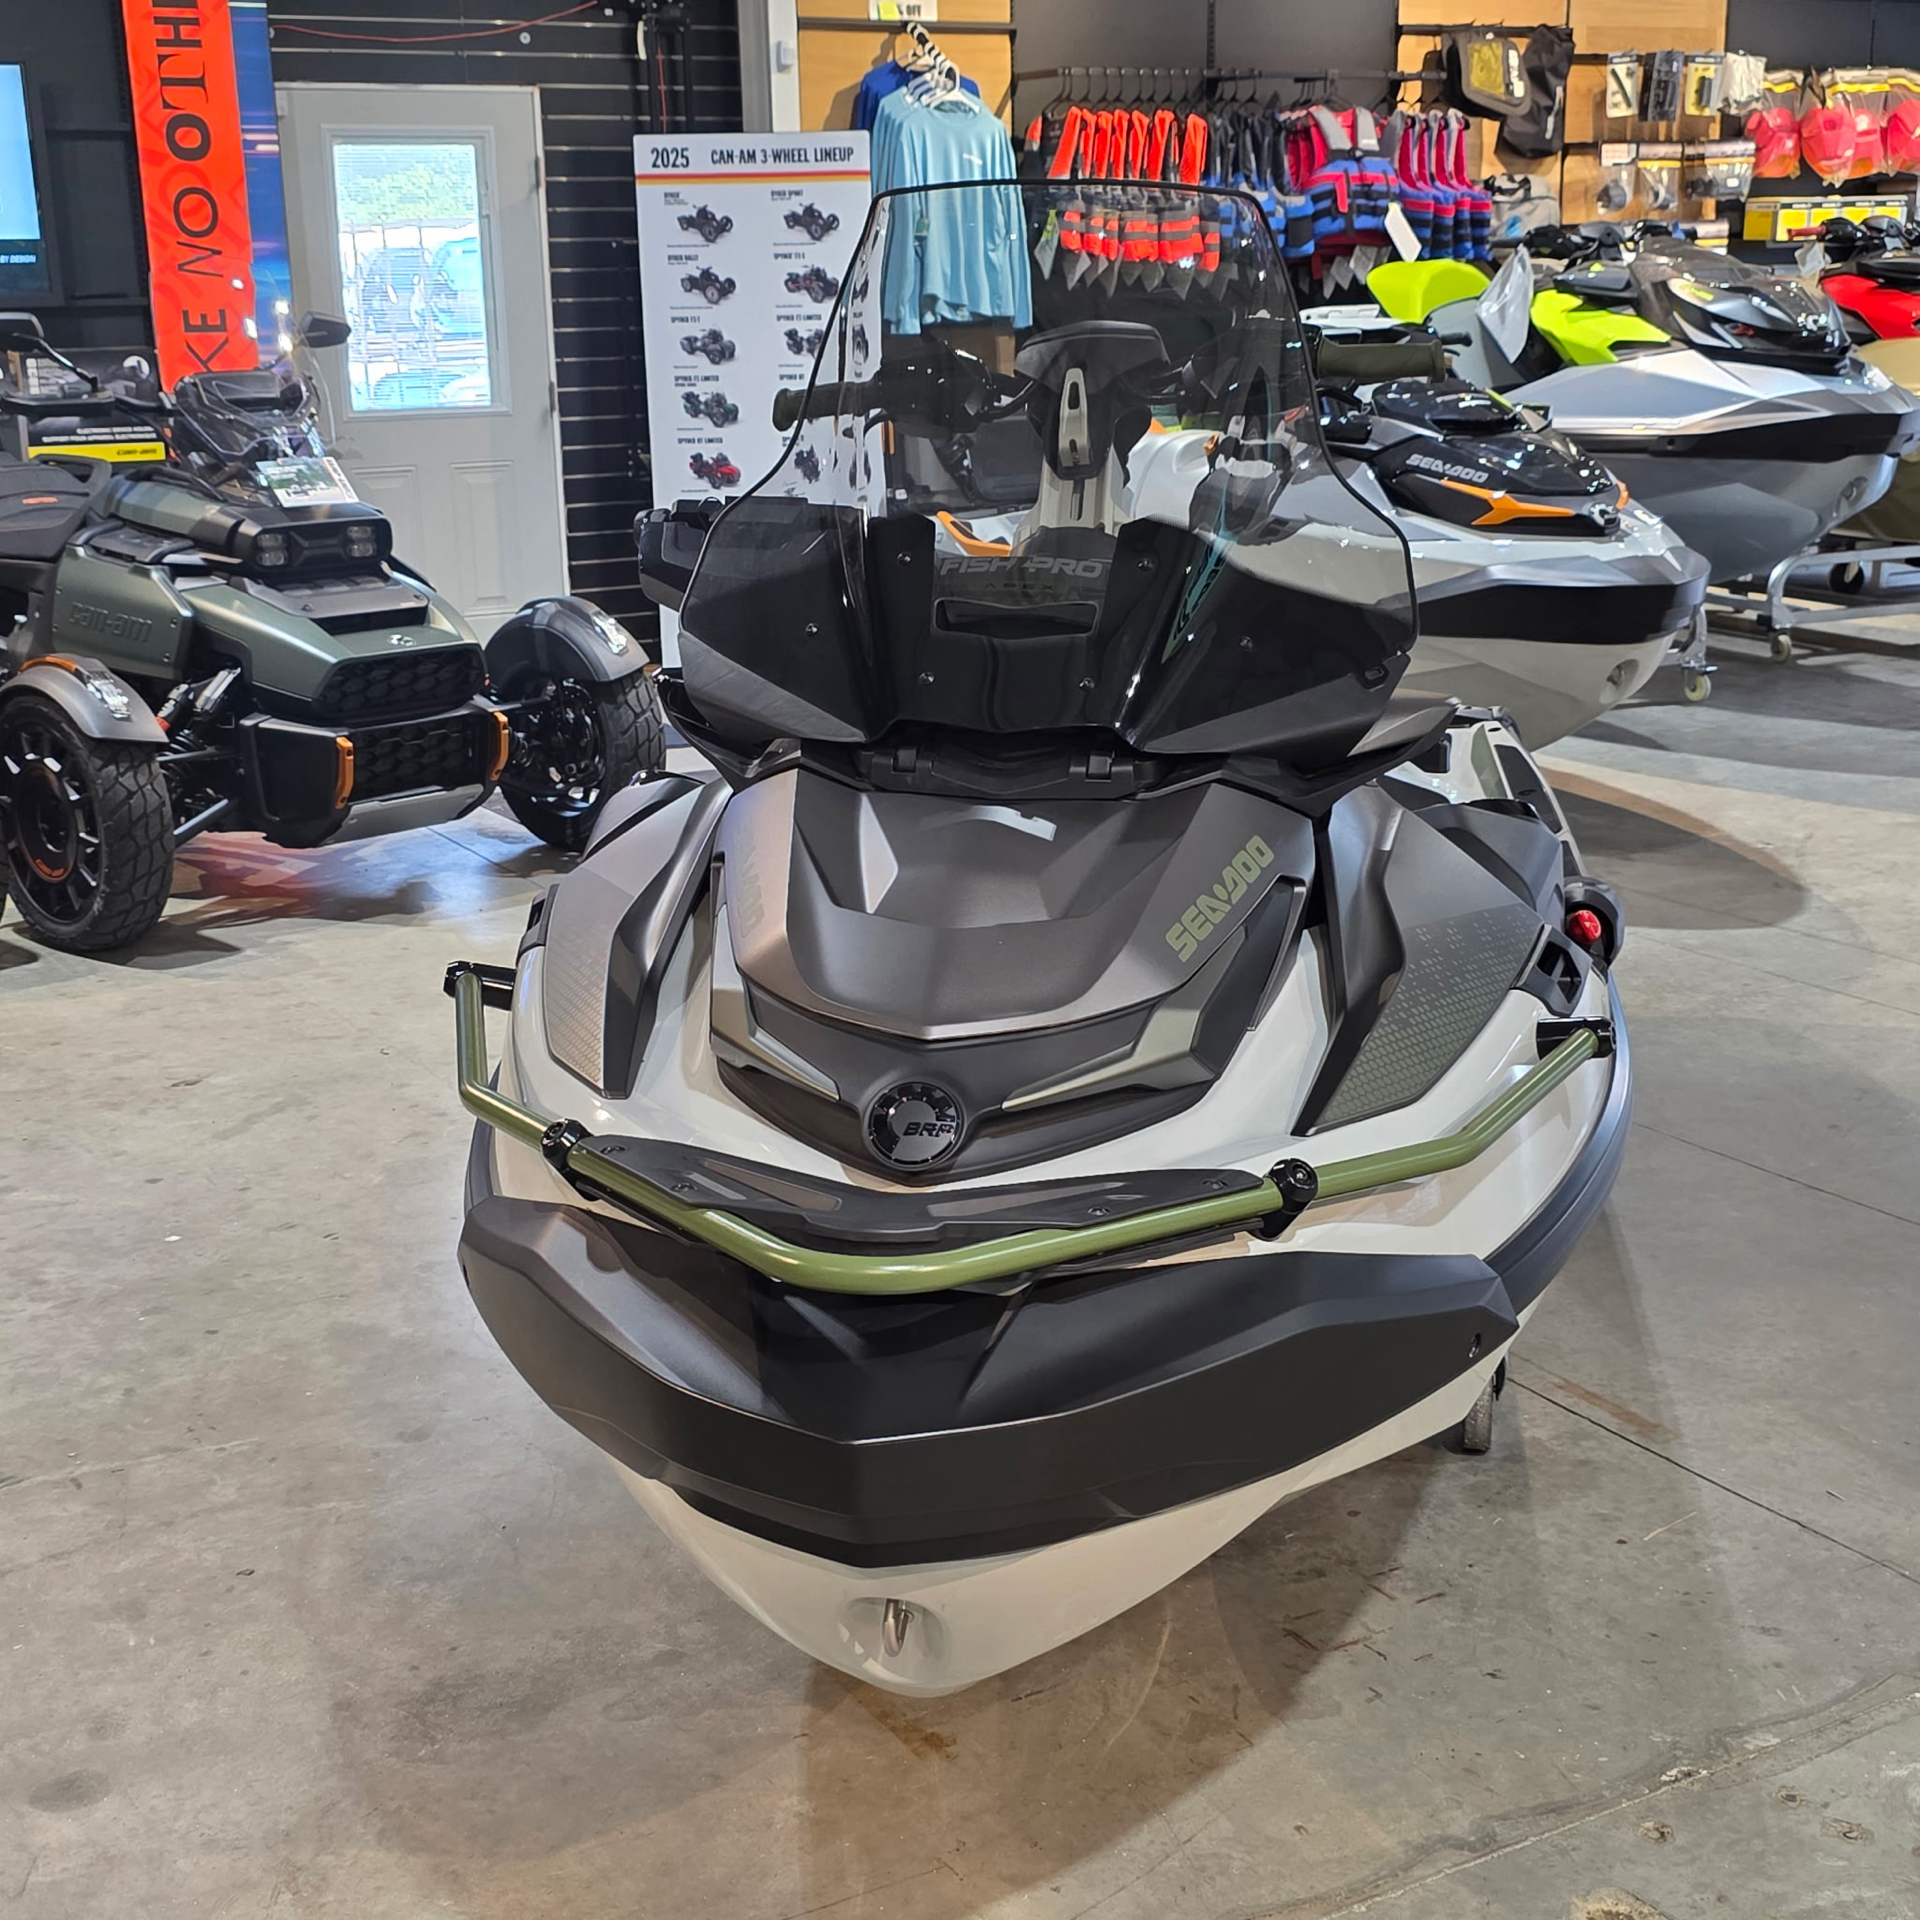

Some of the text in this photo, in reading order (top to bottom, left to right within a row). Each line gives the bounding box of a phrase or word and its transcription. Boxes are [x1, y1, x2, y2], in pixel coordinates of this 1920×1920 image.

[151, 0, 213, 162] OTH
[650, 146, 854, 169] 2025 CAN-AM 3-WHEEL LINEUP
[173, 185, 224, 278] NO
[940, 556, 1103, 579] FISH PRO
[902, 1121, 955, 1138] BRP
